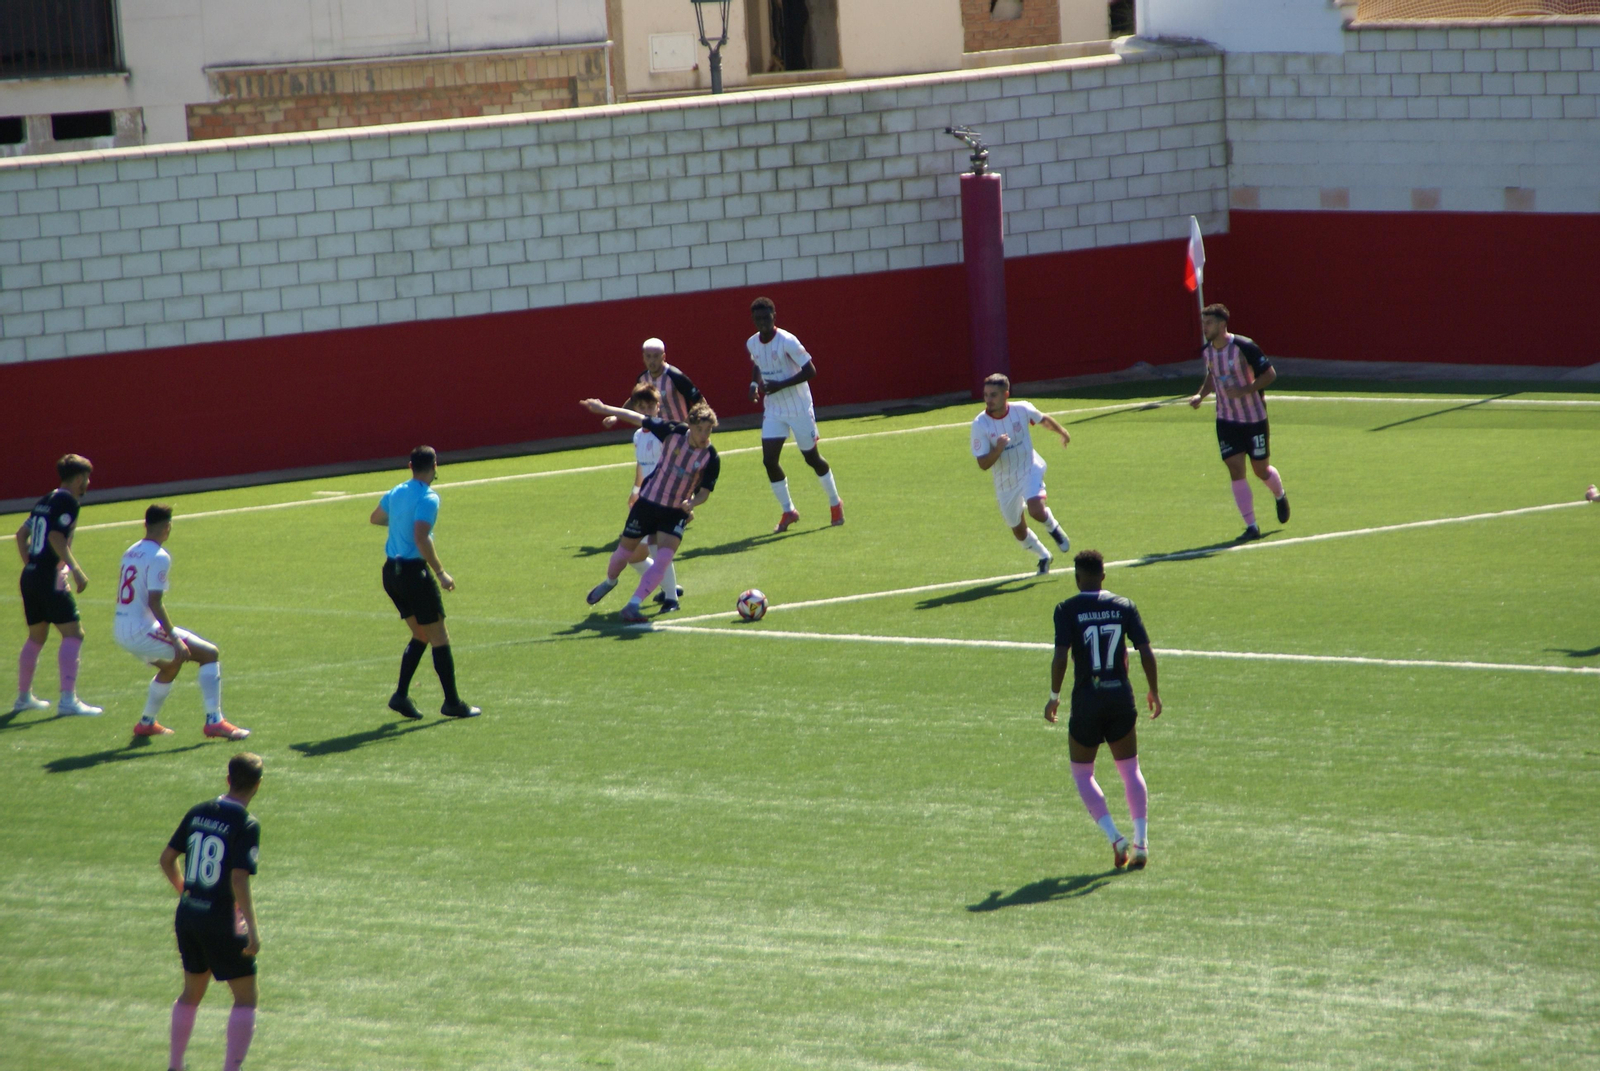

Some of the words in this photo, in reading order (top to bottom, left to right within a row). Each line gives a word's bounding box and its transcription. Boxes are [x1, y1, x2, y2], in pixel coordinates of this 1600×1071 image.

[1253, 434, 1266, 448] 15
[28, 515, 47, 556] 10
[1084, 624, 1122, 670] 17
[185, 831, 225, 886] 18
